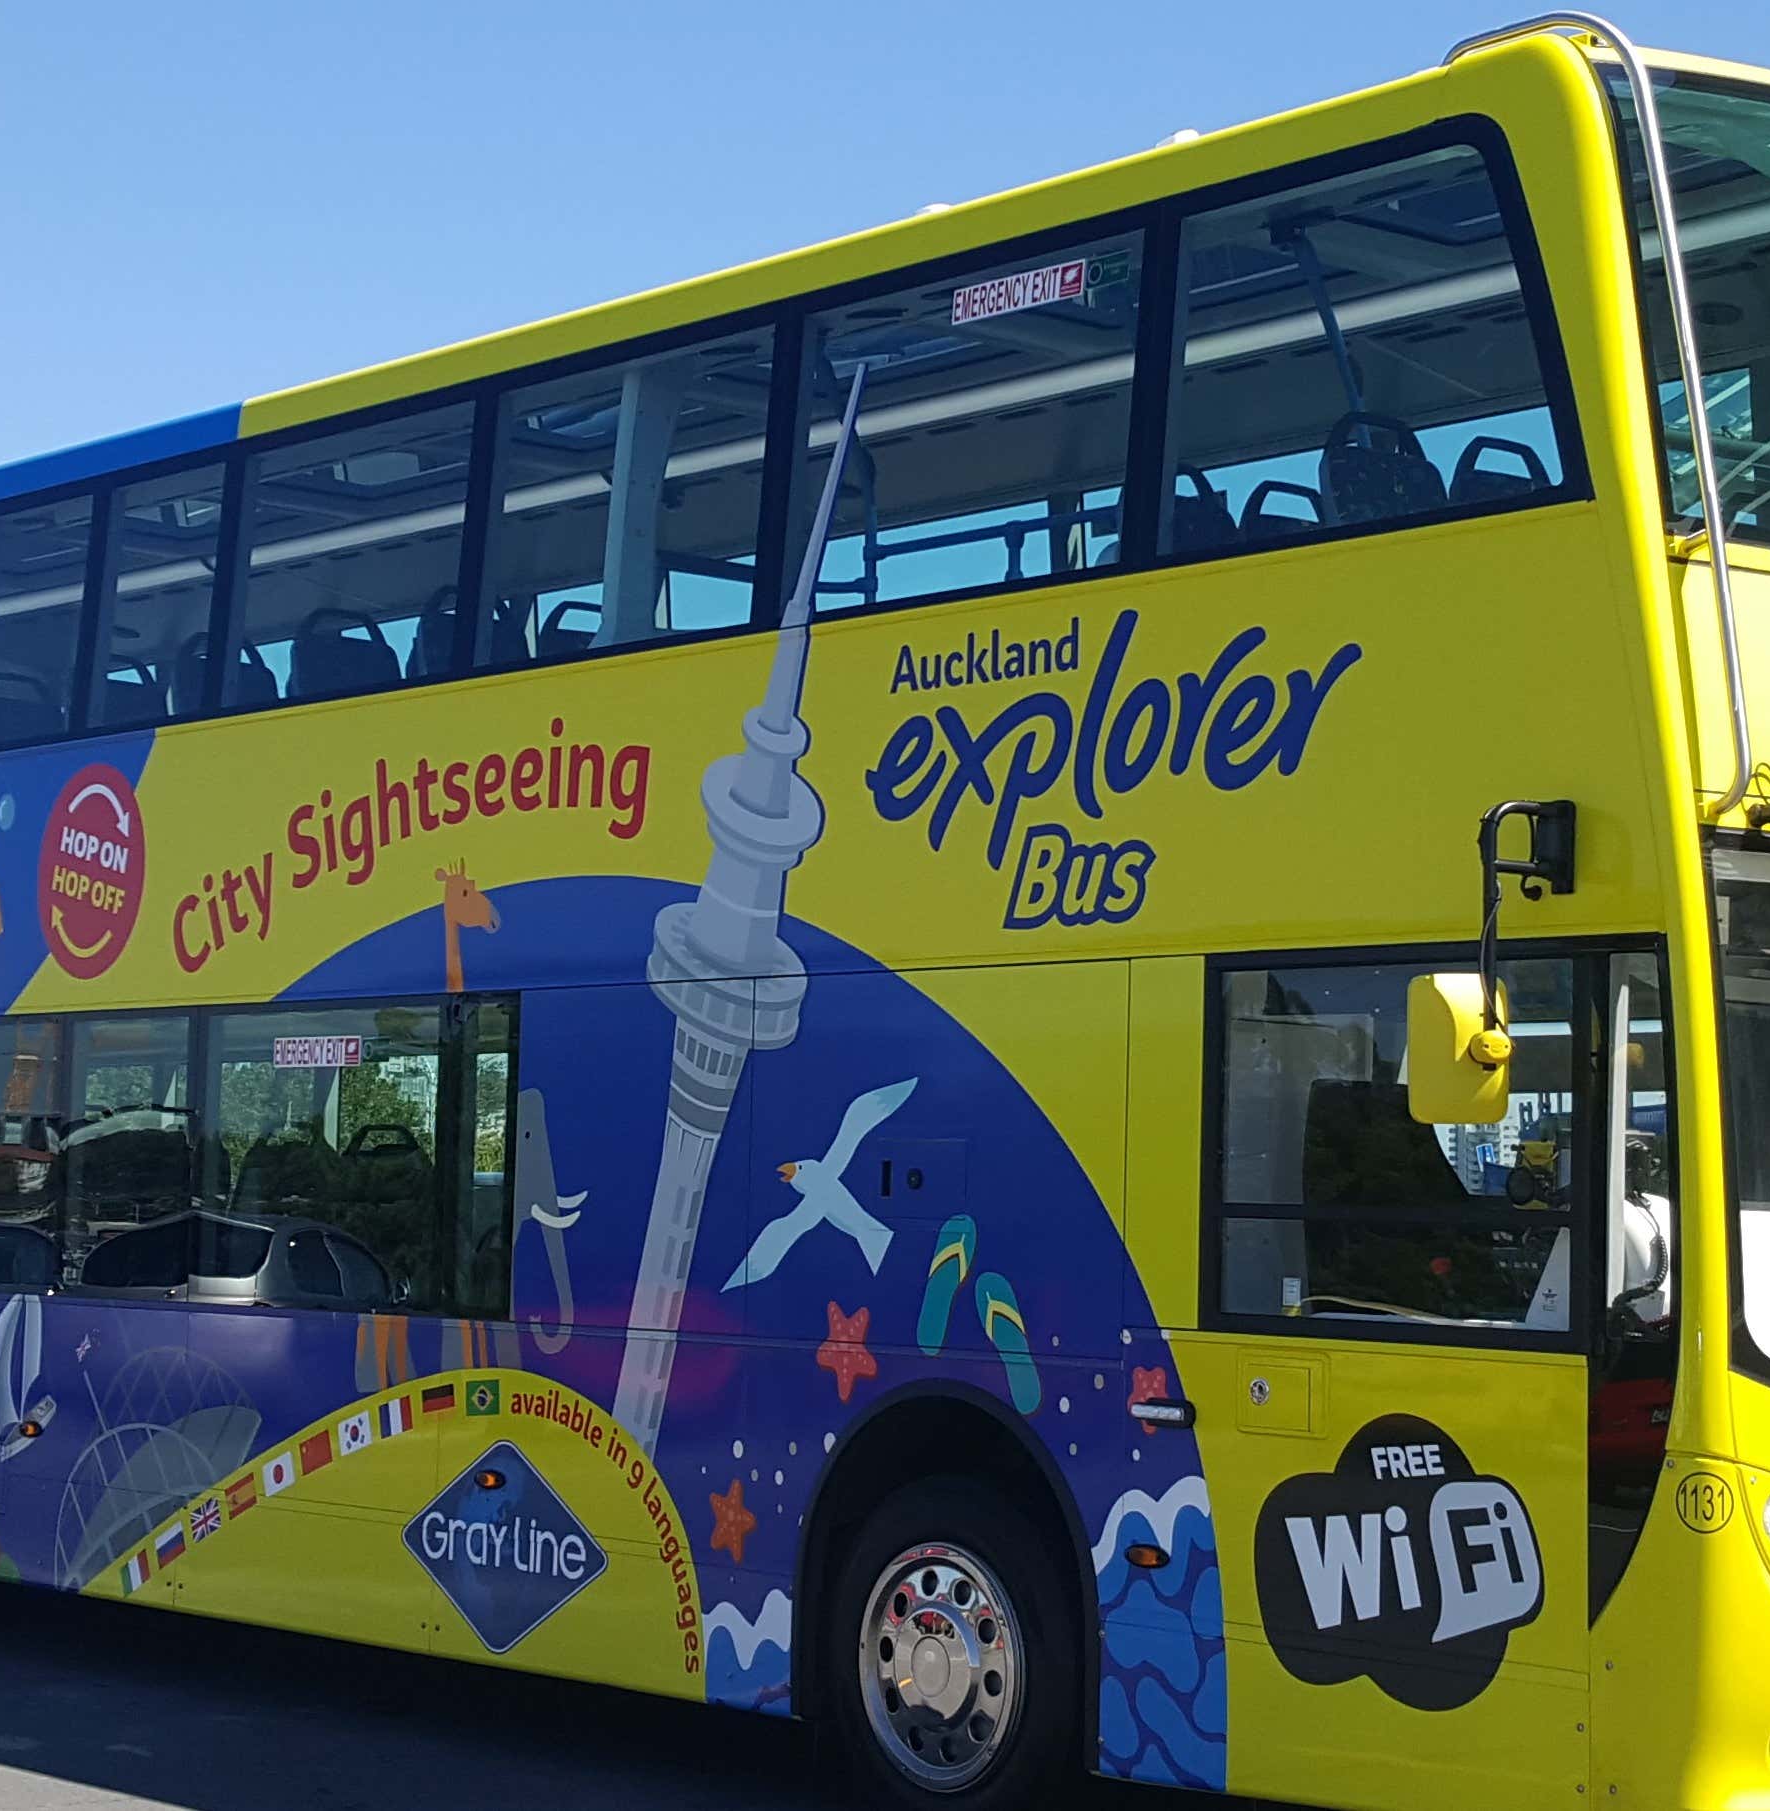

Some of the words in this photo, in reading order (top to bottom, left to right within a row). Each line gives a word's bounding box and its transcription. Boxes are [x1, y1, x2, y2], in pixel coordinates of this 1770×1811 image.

[954, 274, 1030, 322] EMERGENCY
[1032, 267, 1060, 303] EXIT
[890, 617, 1080, 694] Auckland
[865, 609, 1363, 871] explorer
[61, 826, 99, 860] HOP
[101, 841, 128, 873] ON
[172, 852, 273, 973] City
[287, 717, 651, 885] Sightseeing
[52, 866, 89, 900] HOP
[92, 881, 125, 914] OFF
[1002, 823, 1157, 929] Bus
[275, 1039, 327, 1064] EMERGENCY
[327, 1039, 344, 1064] EXIT
[1370, 1443, 1445, 1480] FREE
[1681, 1484, 1726, 1521] 1131
[511, 1390, 602, 1447] available
[607, 1428, 627, 1469] in
[628, 1460, 644, 1489] 9
[643, 1478, 700, 1674] languages
